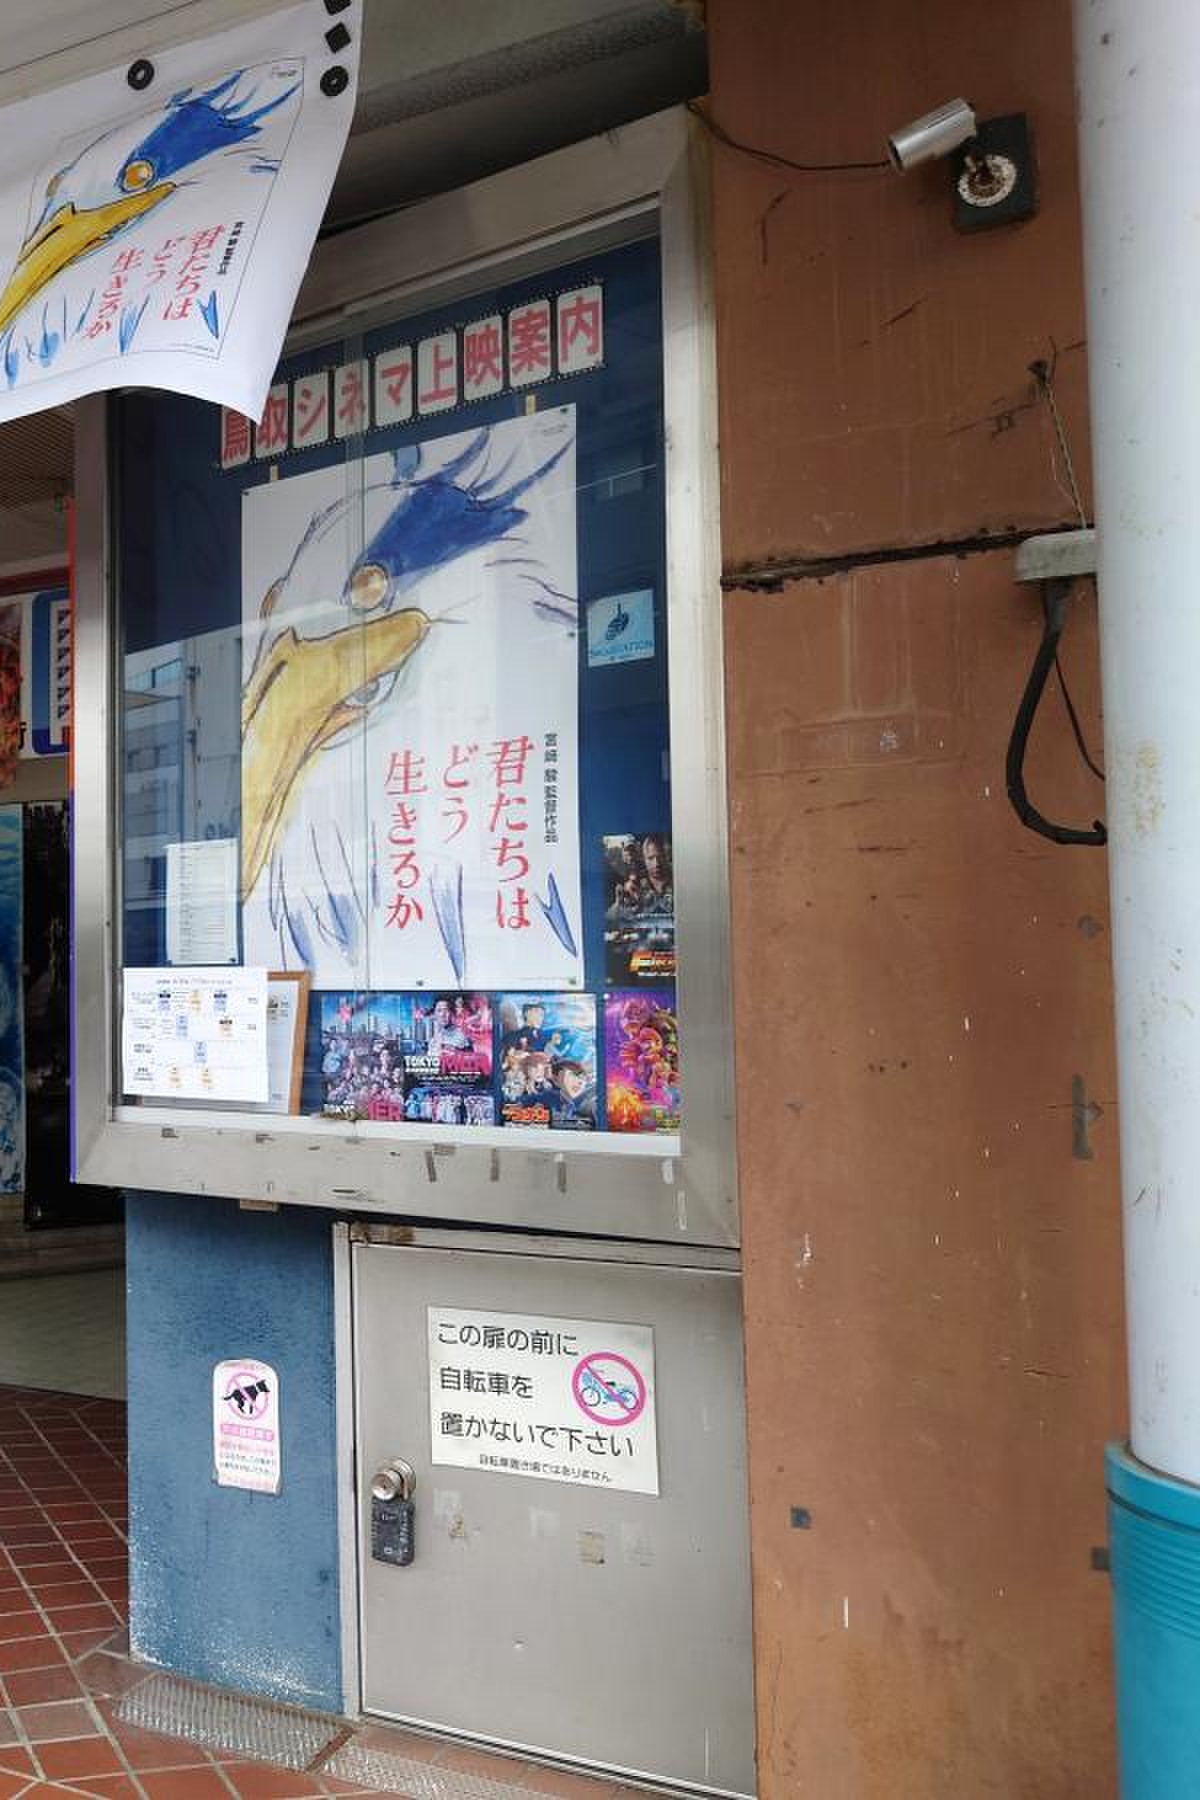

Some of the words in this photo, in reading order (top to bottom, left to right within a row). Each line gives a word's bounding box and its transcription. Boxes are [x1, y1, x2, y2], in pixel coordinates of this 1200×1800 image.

[441, 744, 480, 844] どう
[383, 751, 428, 930] 生きるか
[488, 735, 535, 929] 君たちは
[438, 1322, 579, 1356] この扉の前に
[440, 1366, 533, 1399] 自転車を
[440, 1411, 634, 1457] 置かないで下さい
